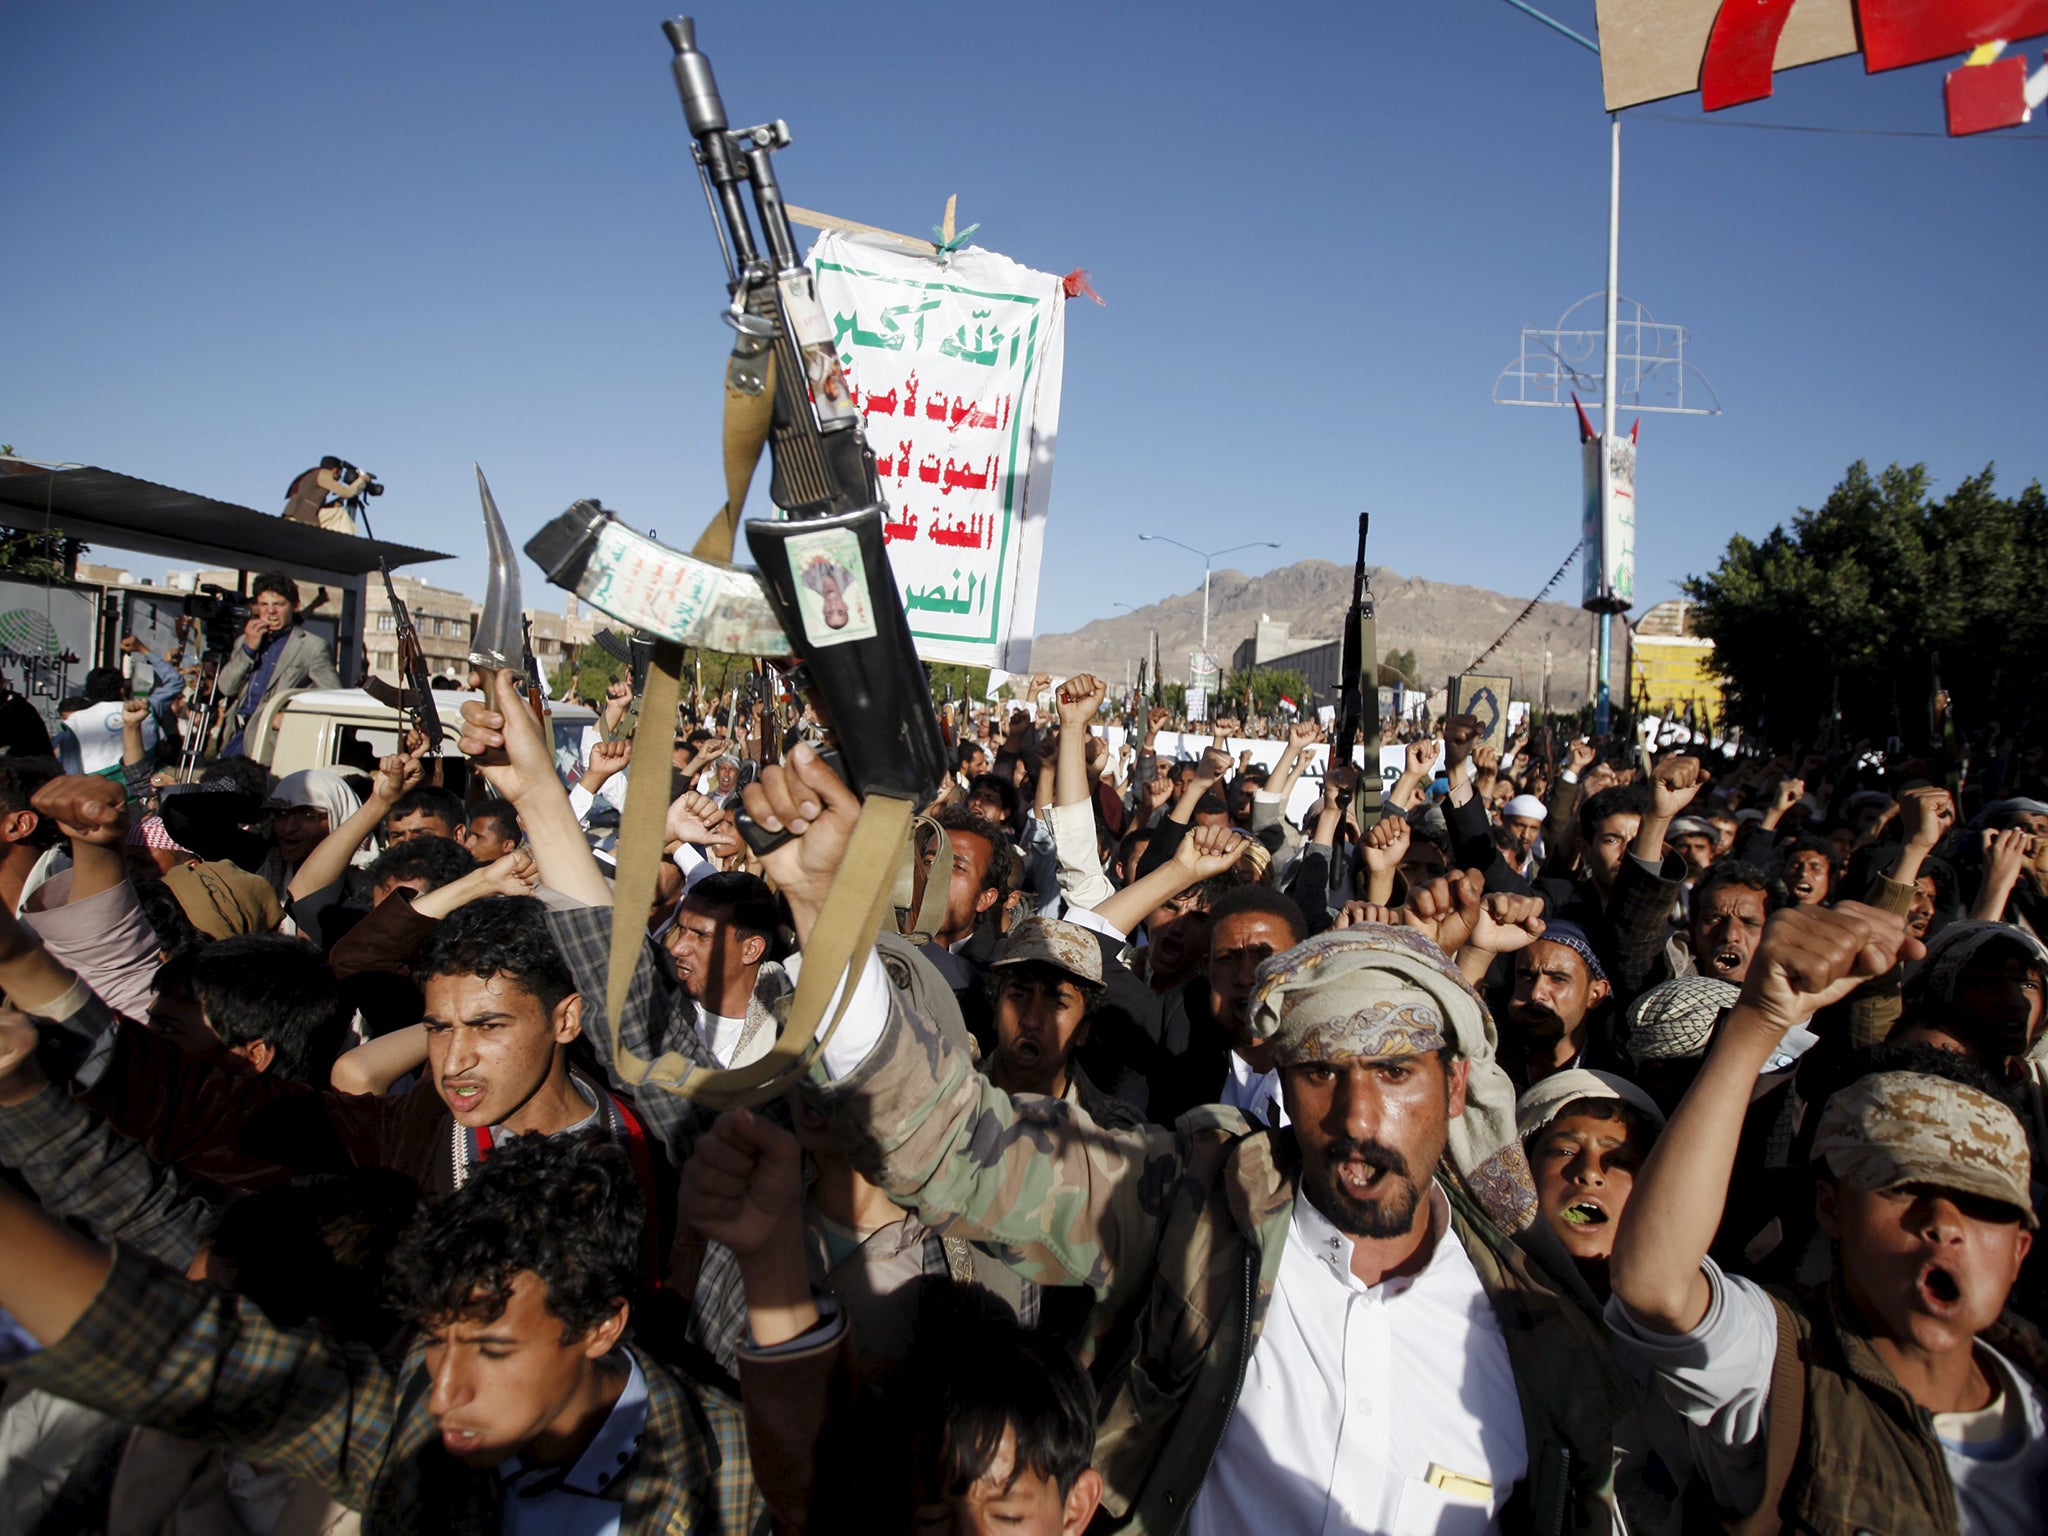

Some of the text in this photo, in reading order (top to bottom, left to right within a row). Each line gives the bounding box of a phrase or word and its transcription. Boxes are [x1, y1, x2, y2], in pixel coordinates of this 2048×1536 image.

[926, 391, 1011, 432] الموت
[919, 453, 999, 495] الموت
[928, 506, 994, 550] اللعنة
[903, 568, 987, 618] النصر
